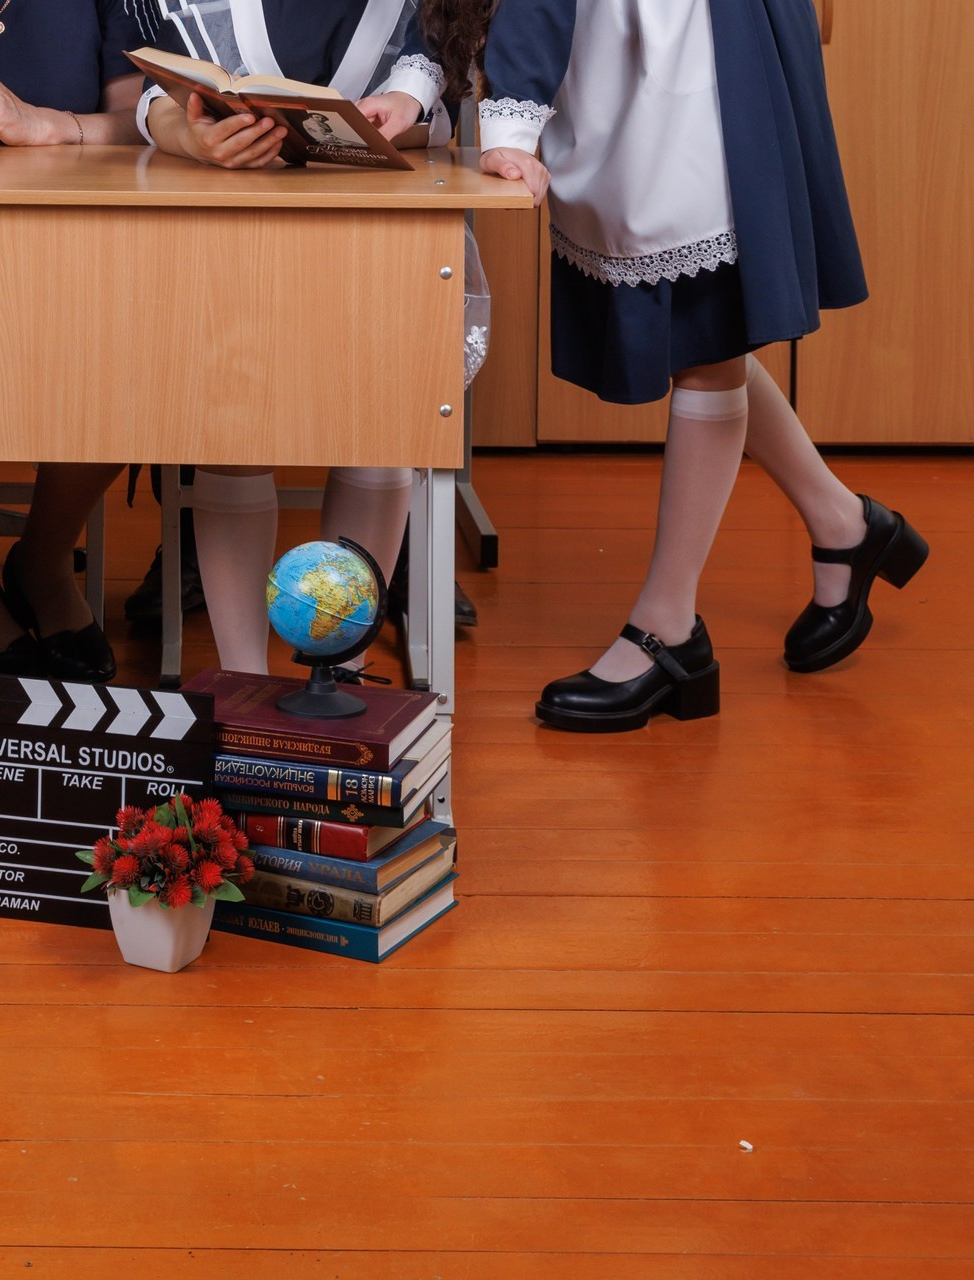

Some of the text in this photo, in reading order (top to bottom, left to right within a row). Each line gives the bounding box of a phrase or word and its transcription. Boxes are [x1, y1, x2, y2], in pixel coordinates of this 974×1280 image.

[218, 732, 331, 755] БУЗДЯКСКАЯ ЭНЦИКЛОП
[62, 773, 103, 790] TAKE
[214, 760, 315, 783] ЭНЦИКЛОПЕДИЯ
[214, 773, 314, 793] БОЛЬШАЯ РОССИЙСКАЯ
[345, 778, 359, 796] 18
[224, 792, 330, 815] АШКИРСКОГО НАРОДА
[253, 852, 363, 882] СТОРИЯ УРАЛА
[248, 916, 280, 934] ЮЛАЕВ
